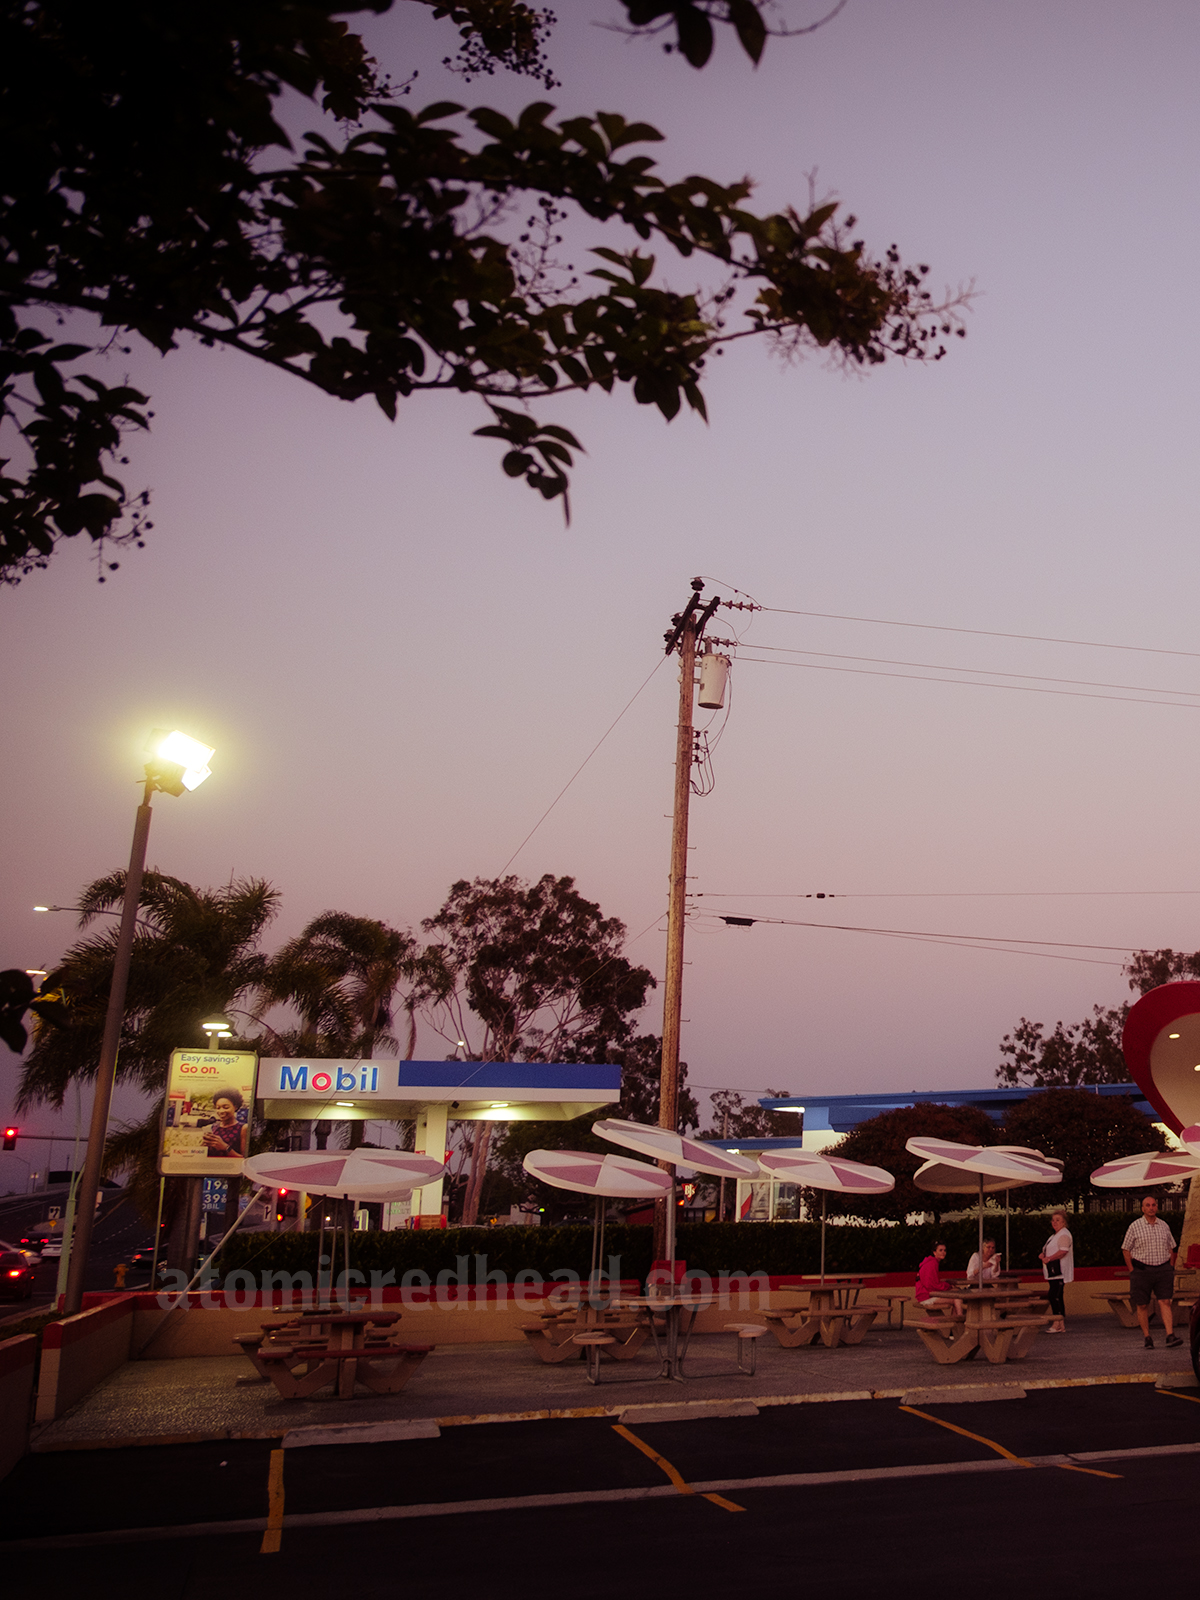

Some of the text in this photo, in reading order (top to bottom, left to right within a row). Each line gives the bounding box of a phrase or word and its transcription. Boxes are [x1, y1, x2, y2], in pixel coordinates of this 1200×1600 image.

[180, 1053, 240, 1065] Easy savings?
[179, 1063, 220, 1074] Go on.
[279, 1065, 379, 1092] Mobil
